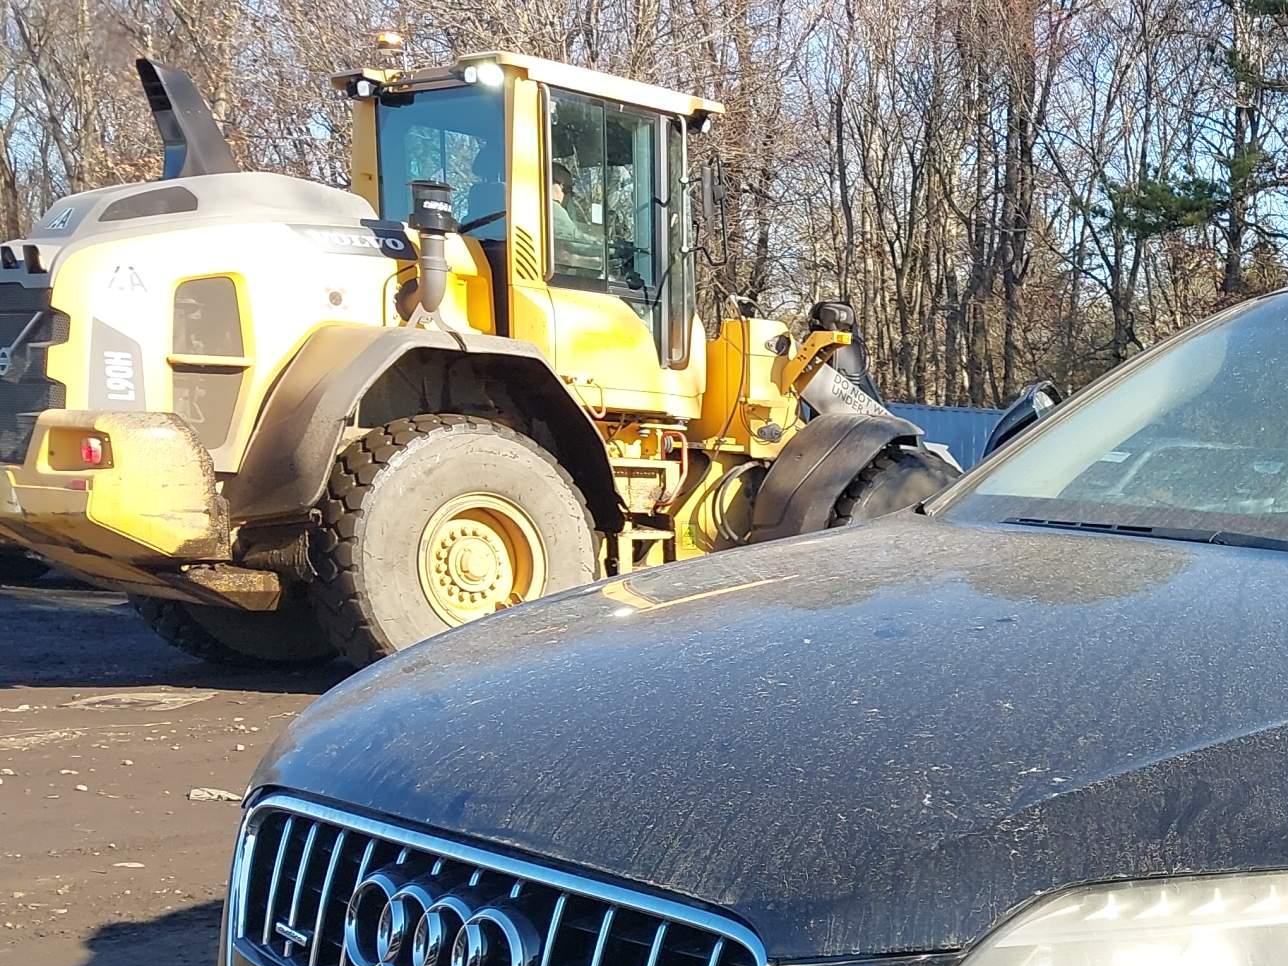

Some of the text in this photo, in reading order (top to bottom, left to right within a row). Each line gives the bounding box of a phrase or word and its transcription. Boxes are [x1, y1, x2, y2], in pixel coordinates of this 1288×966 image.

[103, 351, 136, 401] L90H
[834, 374, 849, 390] DO
[851, 387, 872, 407] NOT
[832, 384, 864, 414] UNDER
